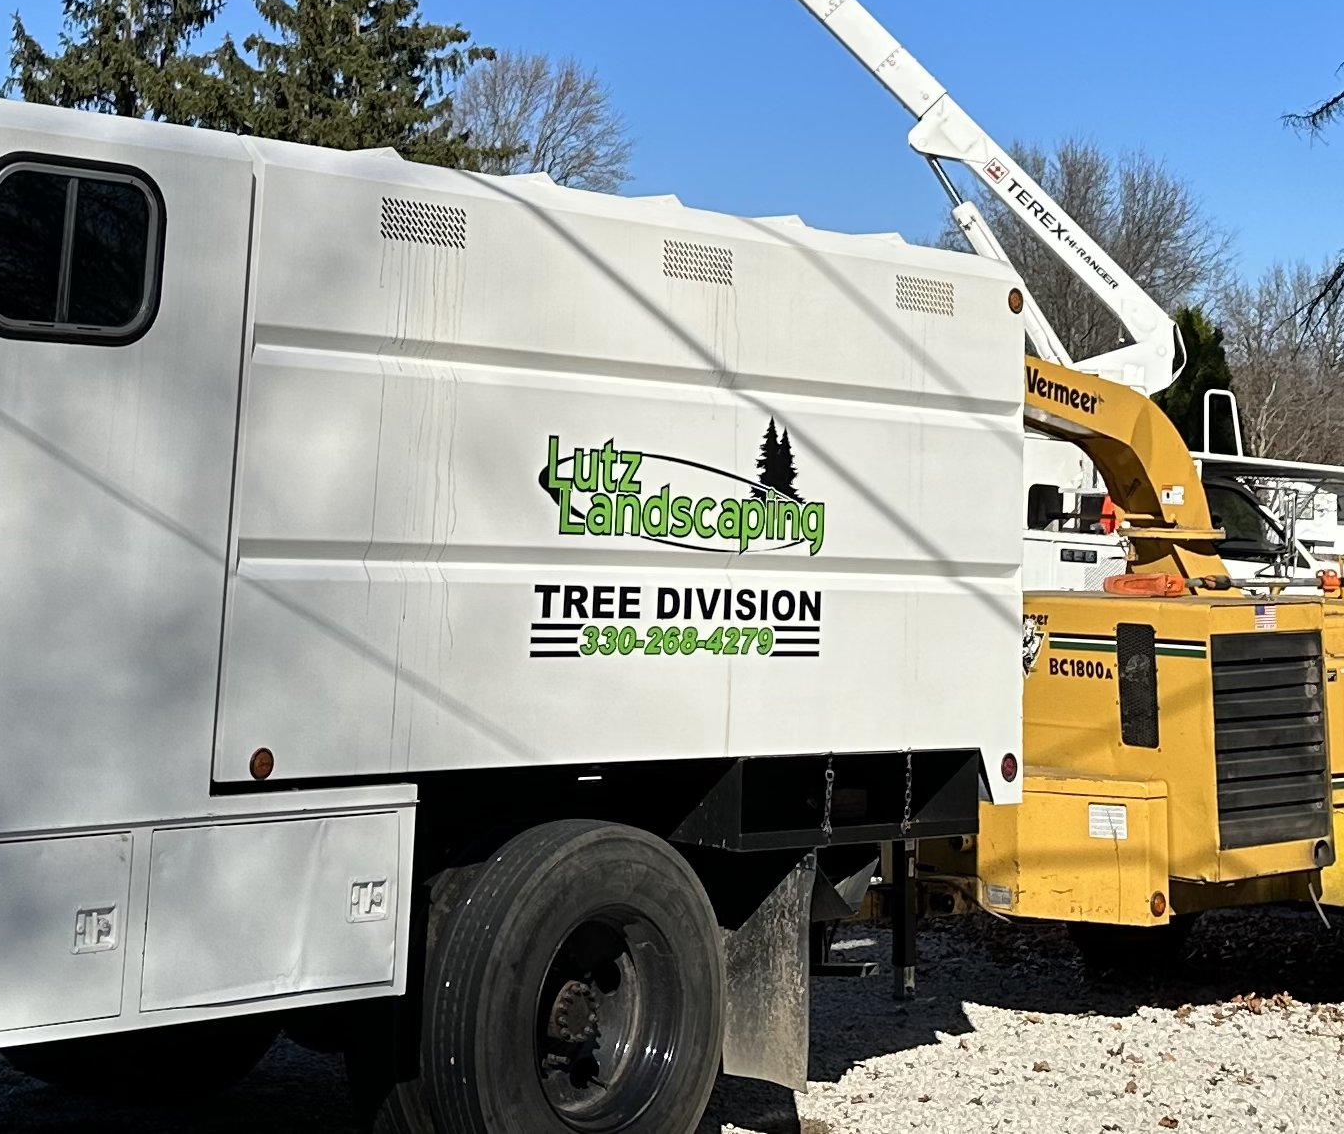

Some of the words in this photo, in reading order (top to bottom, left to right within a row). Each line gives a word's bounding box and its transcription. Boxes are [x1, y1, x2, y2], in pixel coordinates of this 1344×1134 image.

[1007, 178, 1069, 241] TEREX
[1064, 235, 1119, 289] HI-RANGER
[1026, 365, 1097, 415] Vermeer
[548, 435, 642, 494] Lutz
[558, 483, 825, 557] Landscaping
[534, 584, 642, 619] TREE
[656, 586, 822, 622] DIVISION
[579, 625, 775, 656] 330-268-4279
[1049, 657, 1113, 680] BC1800A
